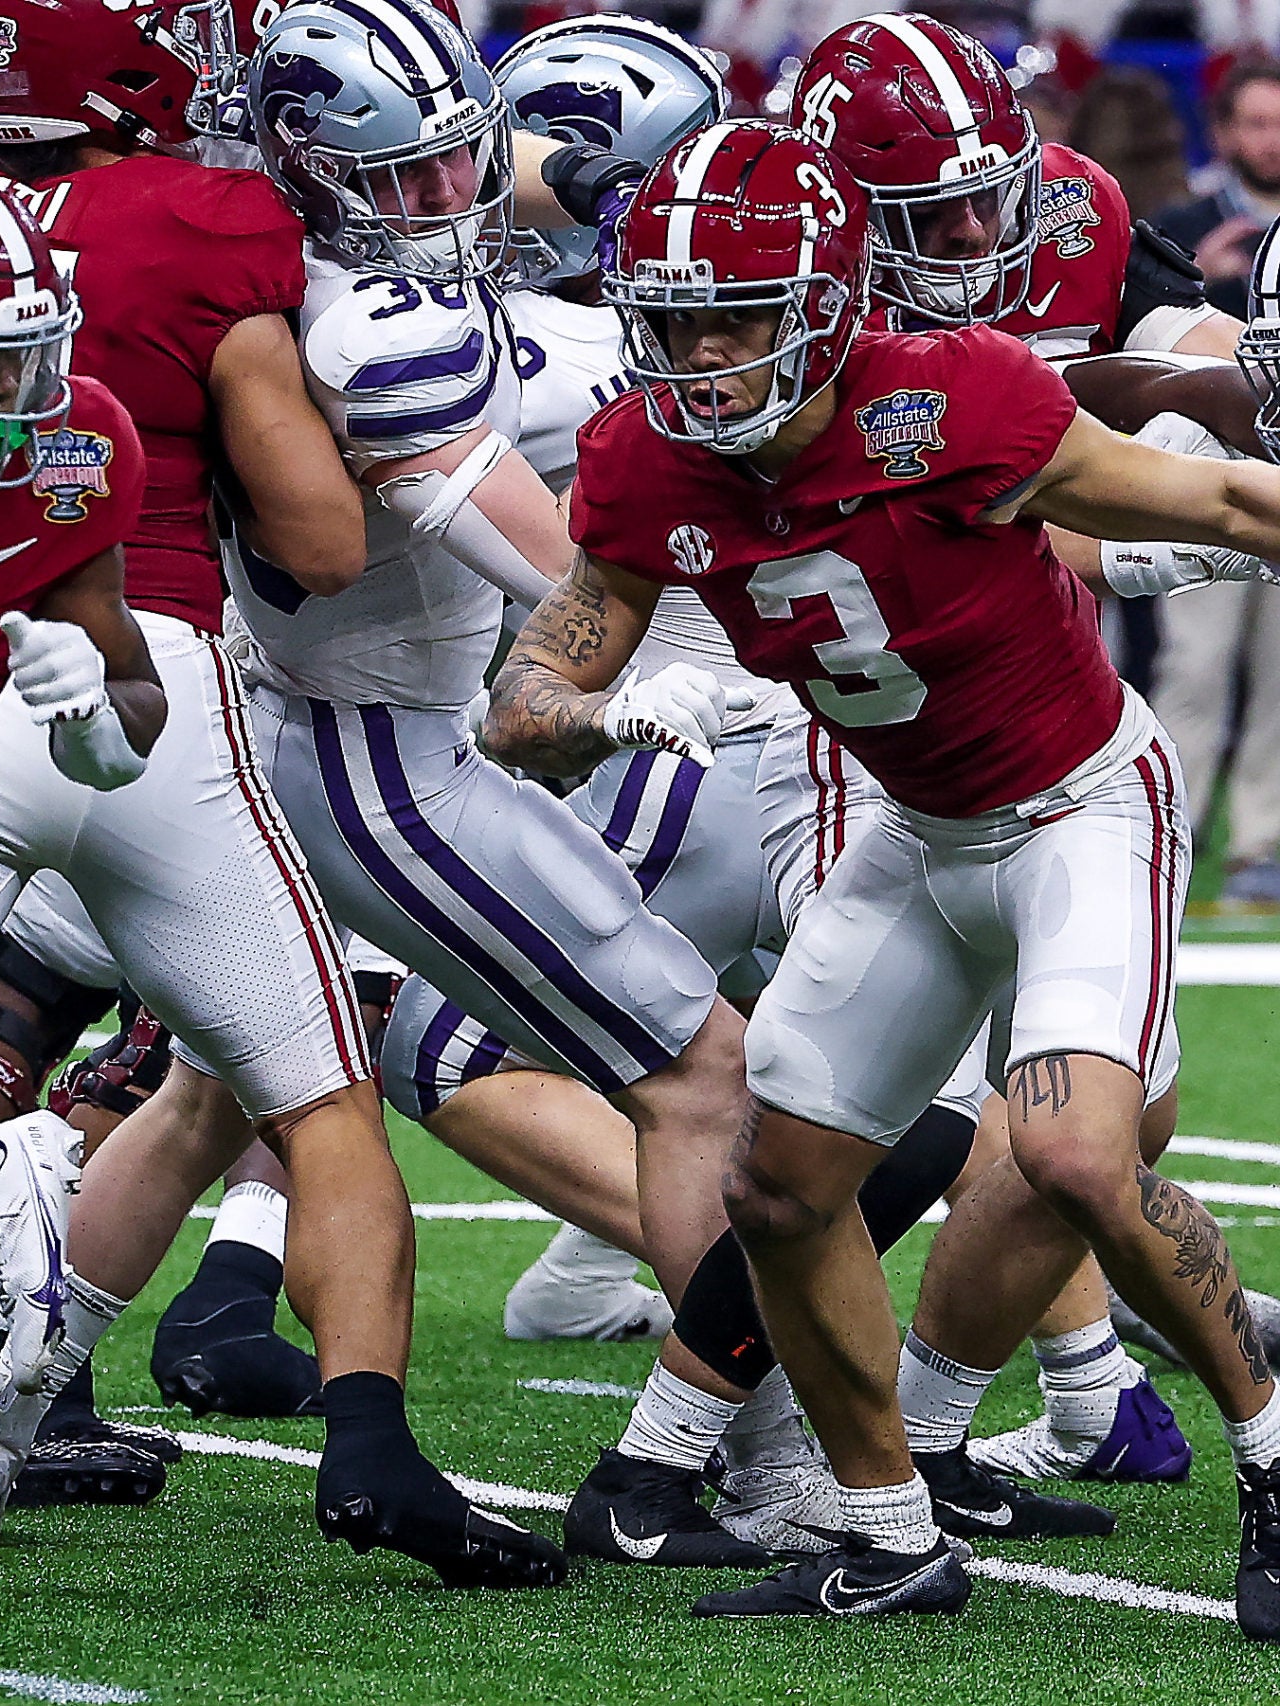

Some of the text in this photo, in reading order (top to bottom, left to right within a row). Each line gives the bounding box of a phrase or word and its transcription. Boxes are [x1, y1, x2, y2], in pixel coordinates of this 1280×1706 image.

[434, 103, 477, 134] K-STATE
[801, 72, 854, 148] 45
[795, 163, 847, 227] 3
[16, 302, 50, 321] BAMA
[870, 406, 930, 430] Allstate
[667, 524, 714, 575] SEC
[746, 550, 928, 727] 3
